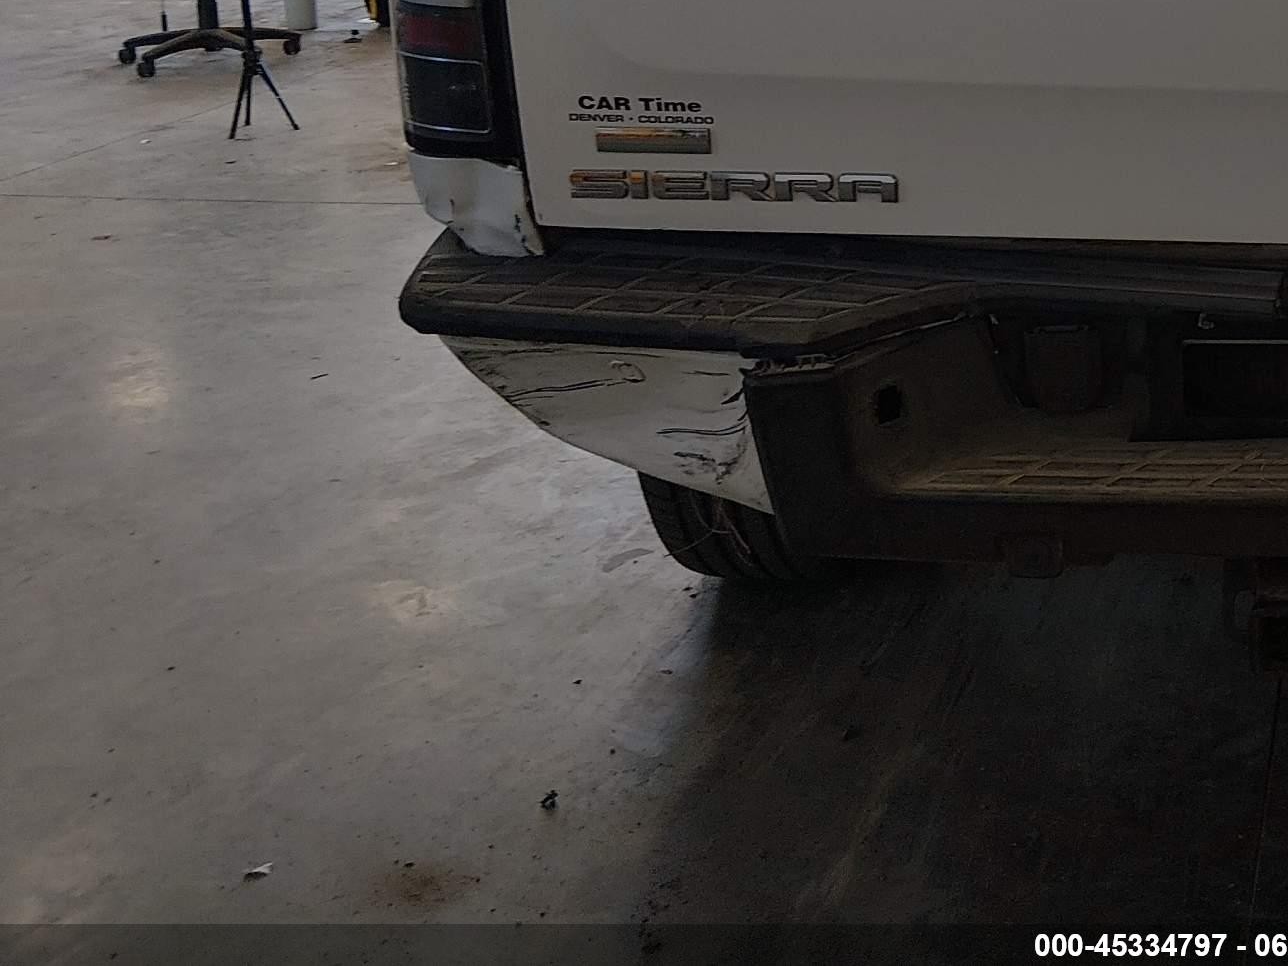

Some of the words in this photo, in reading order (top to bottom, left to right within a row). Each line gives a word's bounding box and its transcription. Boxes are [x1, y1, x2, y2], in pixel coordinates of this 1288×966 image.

[577, 95, 631, 111] CAR
[638, 97, 702, 112] Time
[568, 113, 624, 123] DENVER
[638, 115, 714, 125] COLORADO
